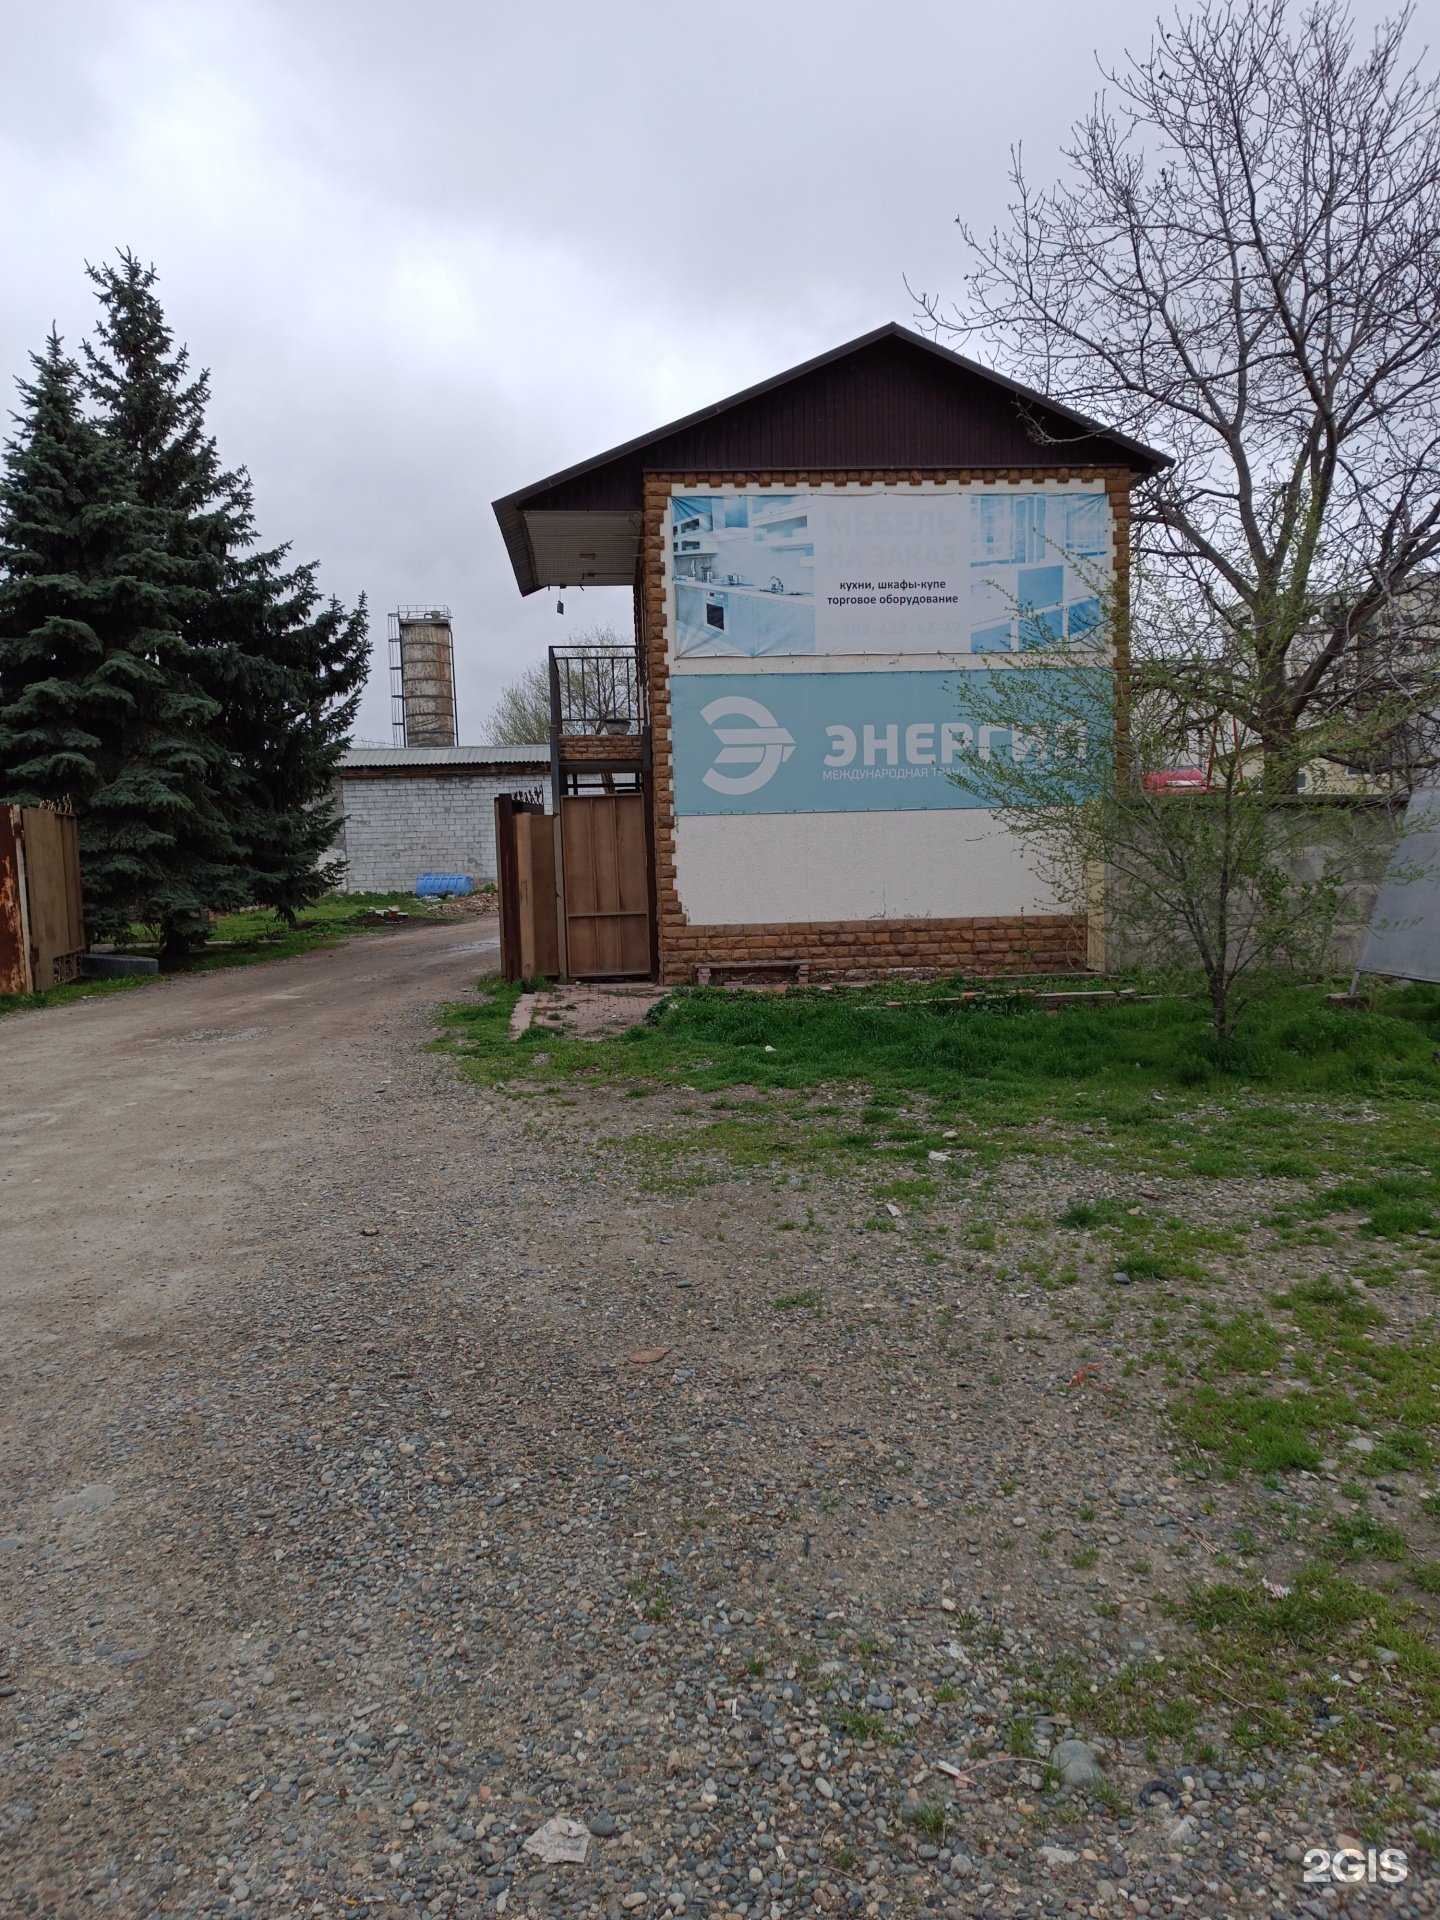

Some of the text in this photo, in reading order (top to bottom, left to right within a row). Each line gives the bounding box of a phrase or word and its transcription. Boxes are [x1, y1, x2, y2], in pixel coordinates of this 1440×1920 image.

[839, 579, 947, 592] кухни, шкафы-купе
[827, 594, 959, 607] торговое оборудование
[822, 766, 929, 781] МЕЖДУНАРОДНАЯ
